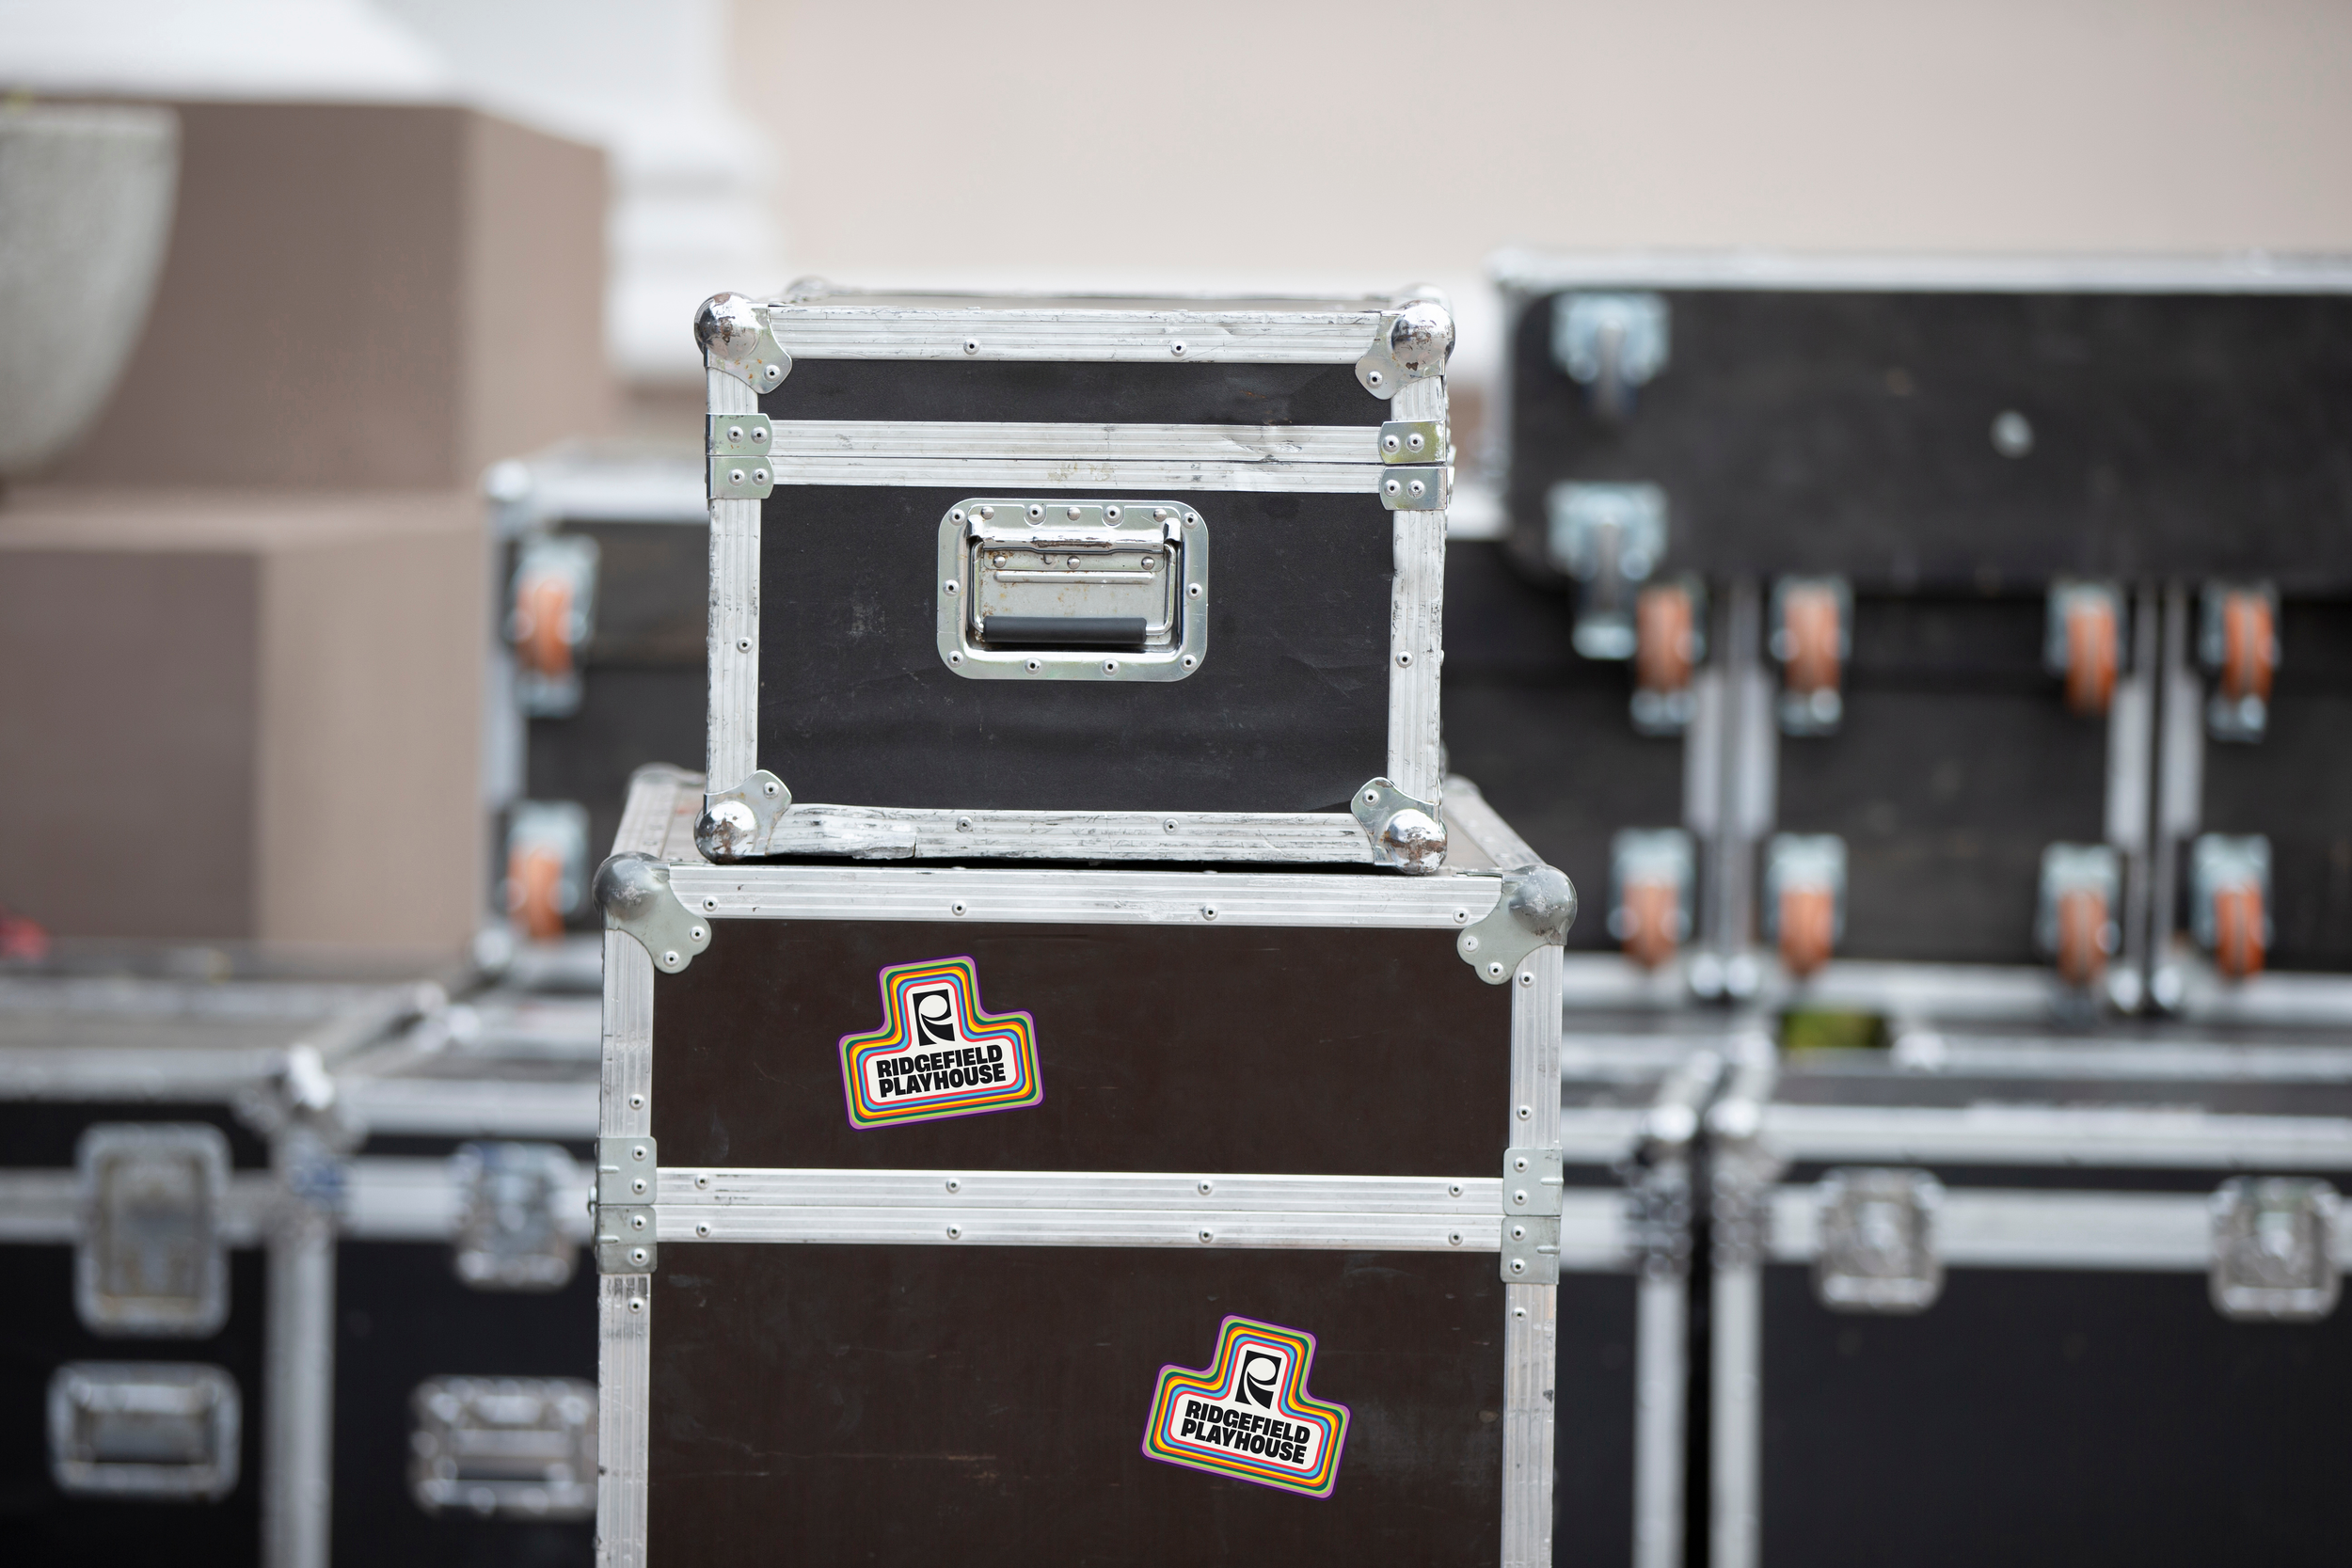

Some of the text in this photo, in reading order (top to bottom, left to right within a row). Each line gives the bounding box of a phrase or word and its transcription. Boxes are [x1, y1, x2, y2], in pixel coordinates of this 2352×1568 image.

[876, 1044, 1003, 1079] RIDGEFIELD
[878, 1062, 1007, 1099] PLAYHOUSE
[1180, 1418, 1308, 1465] PLAYHOUSE
[1184, 1399, 1311, 1445] RIDGEFIELD
